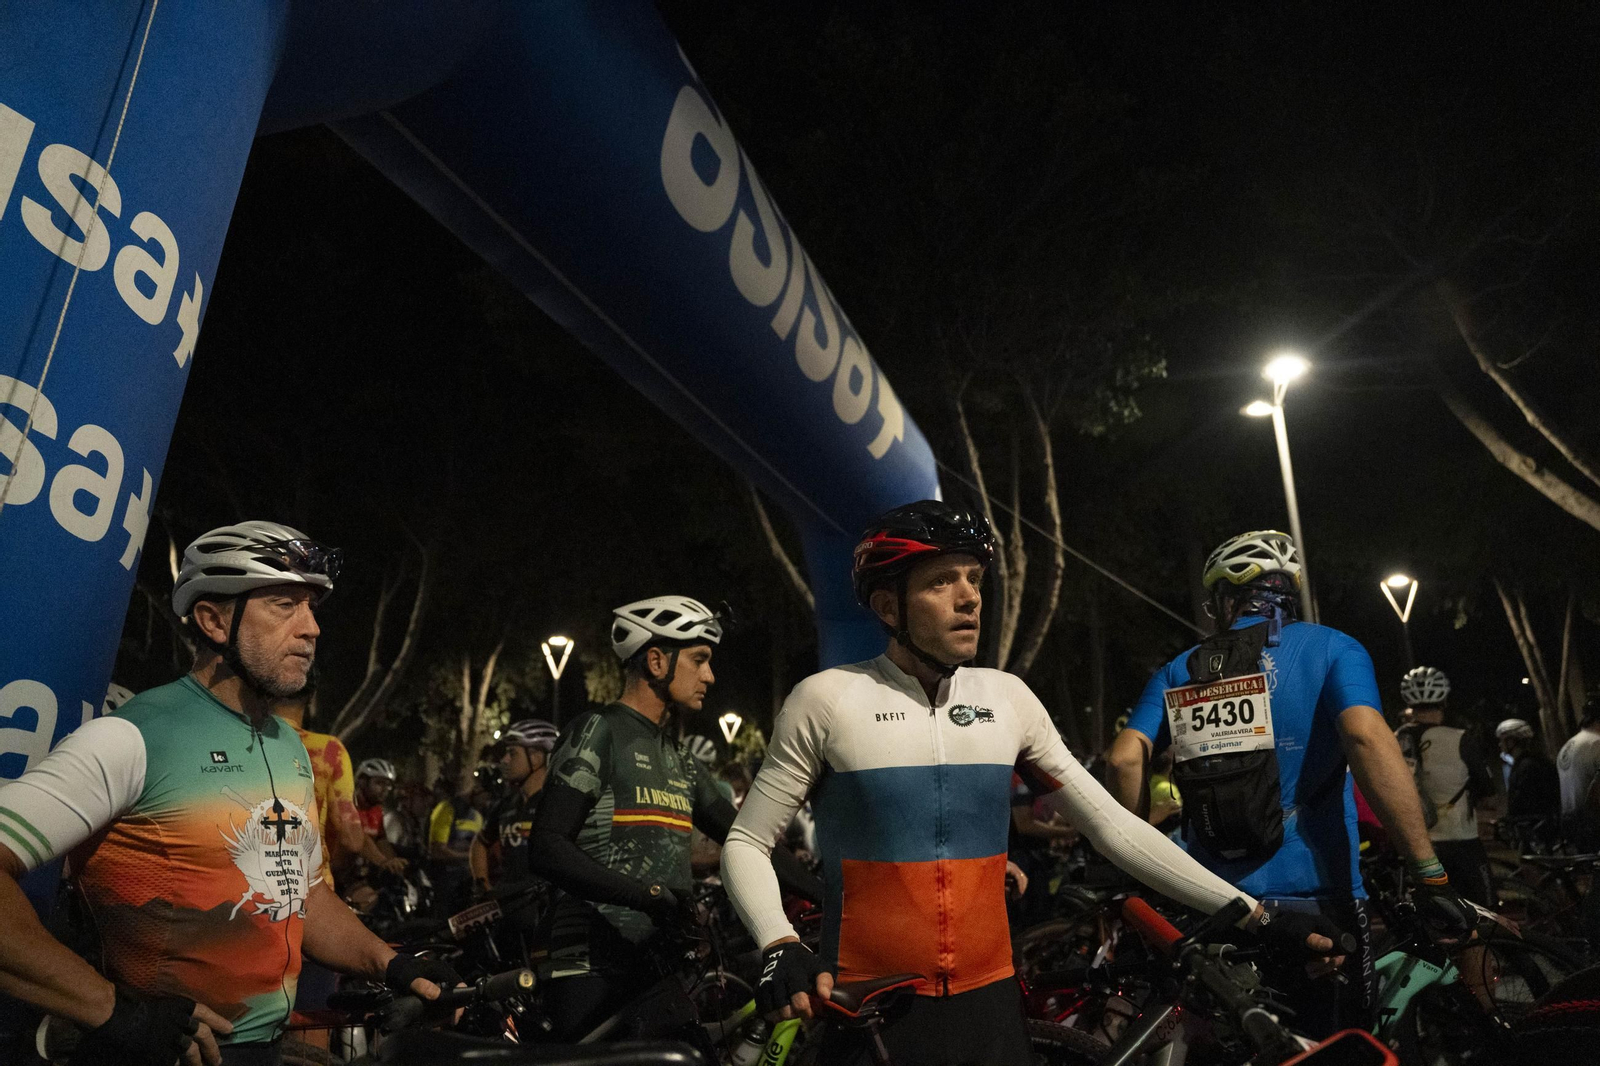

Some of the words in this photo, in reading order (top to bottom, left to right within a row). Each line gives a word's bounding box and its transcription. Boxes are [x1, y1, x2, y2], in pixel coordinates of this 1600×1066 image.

[875, 712, 906, 722] BKFIT
[1191, 699, 1255, 731] 5430
[1210, 741, 1243, 750] cajamar
[201, 764, 245, 773] kavant
[636, 786, 651, 804] LA
[264, 848, 299, 858] MARATÓN
[759, 949, 784, 987] FOX
